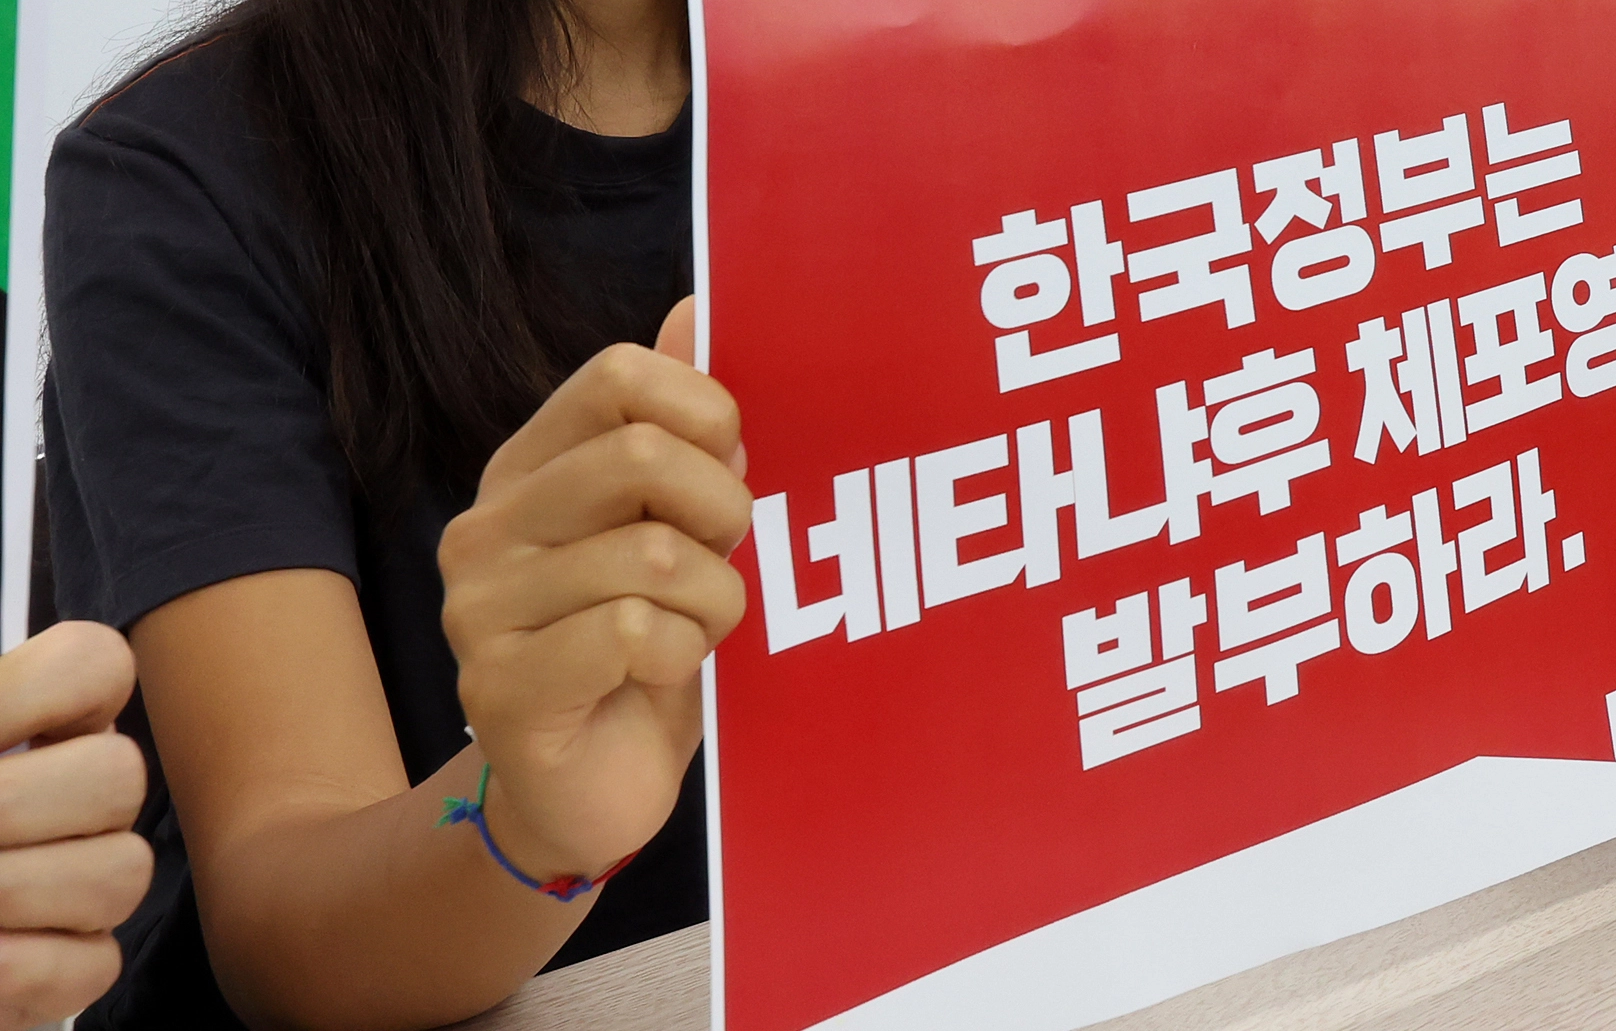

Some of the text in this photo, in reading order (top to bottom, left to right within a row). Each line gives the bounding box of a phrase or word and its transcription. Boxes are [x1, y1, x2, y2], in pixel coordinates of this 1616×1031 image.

[972, 101, 1583, 393] 한국정부는
[753, 349, 1332, 654] 네타냐후
[1062, 447, 1587, 771] 발부하라.
